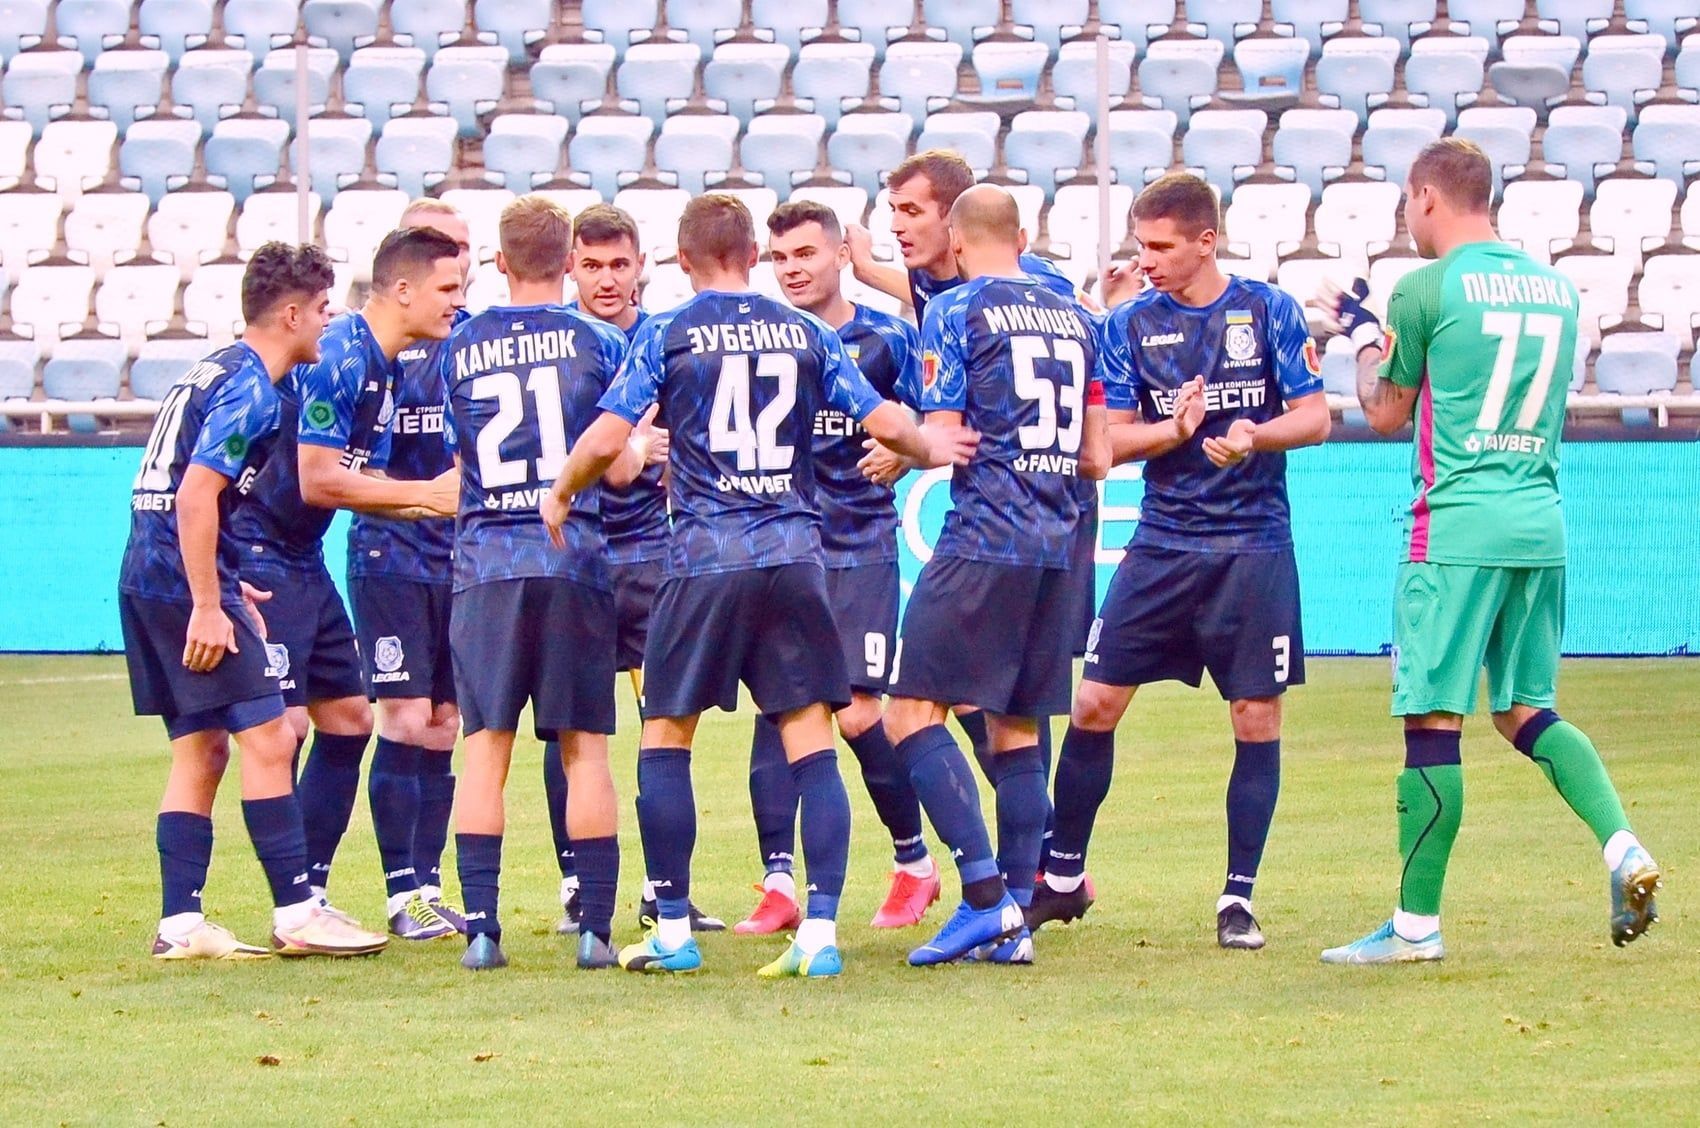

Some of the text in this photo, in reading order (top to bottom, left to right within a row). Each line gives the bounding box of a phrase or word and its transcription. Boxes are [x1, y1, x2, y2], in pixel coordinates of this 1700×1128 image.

[1461, 272, 1573, 310] ПІДКІВКА
[687, 319, 808, 354] ЗУБЕЙКО
[982, 304, 1087, 341] МИКИЦЕЙ
[1141, 332, 1185, 347] LEGEA
[455, 329, 577, 380] КАМЕЛЮК
[1475, 311, 1563, 432] 77
[708, 353, 798, 471] 42
[1010, 335, 1086, 453] 53
[470, 365, 571, 489] 21
[1028, 454, 1078, 477] FAVET
[864, 631, 886, 679] 9
[1272, 635, 1290, 683] 3
